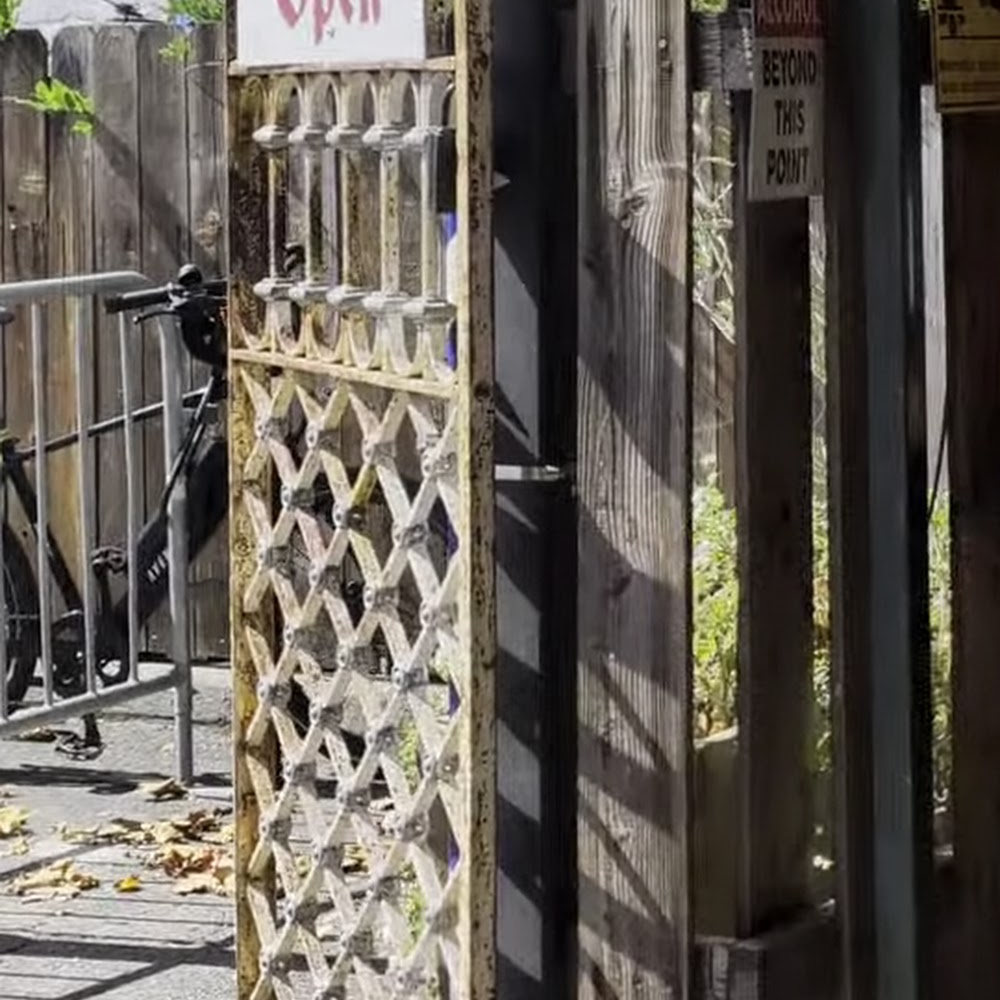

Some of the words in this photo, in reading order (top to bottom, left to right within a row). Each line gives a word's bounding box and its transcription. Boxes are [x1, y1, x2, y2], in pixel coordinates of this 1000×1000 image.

[762, 49, 817, 86] BEYOND
[775, 99, 805, 136] THIS
[766, 146, 809, 186] POINT
